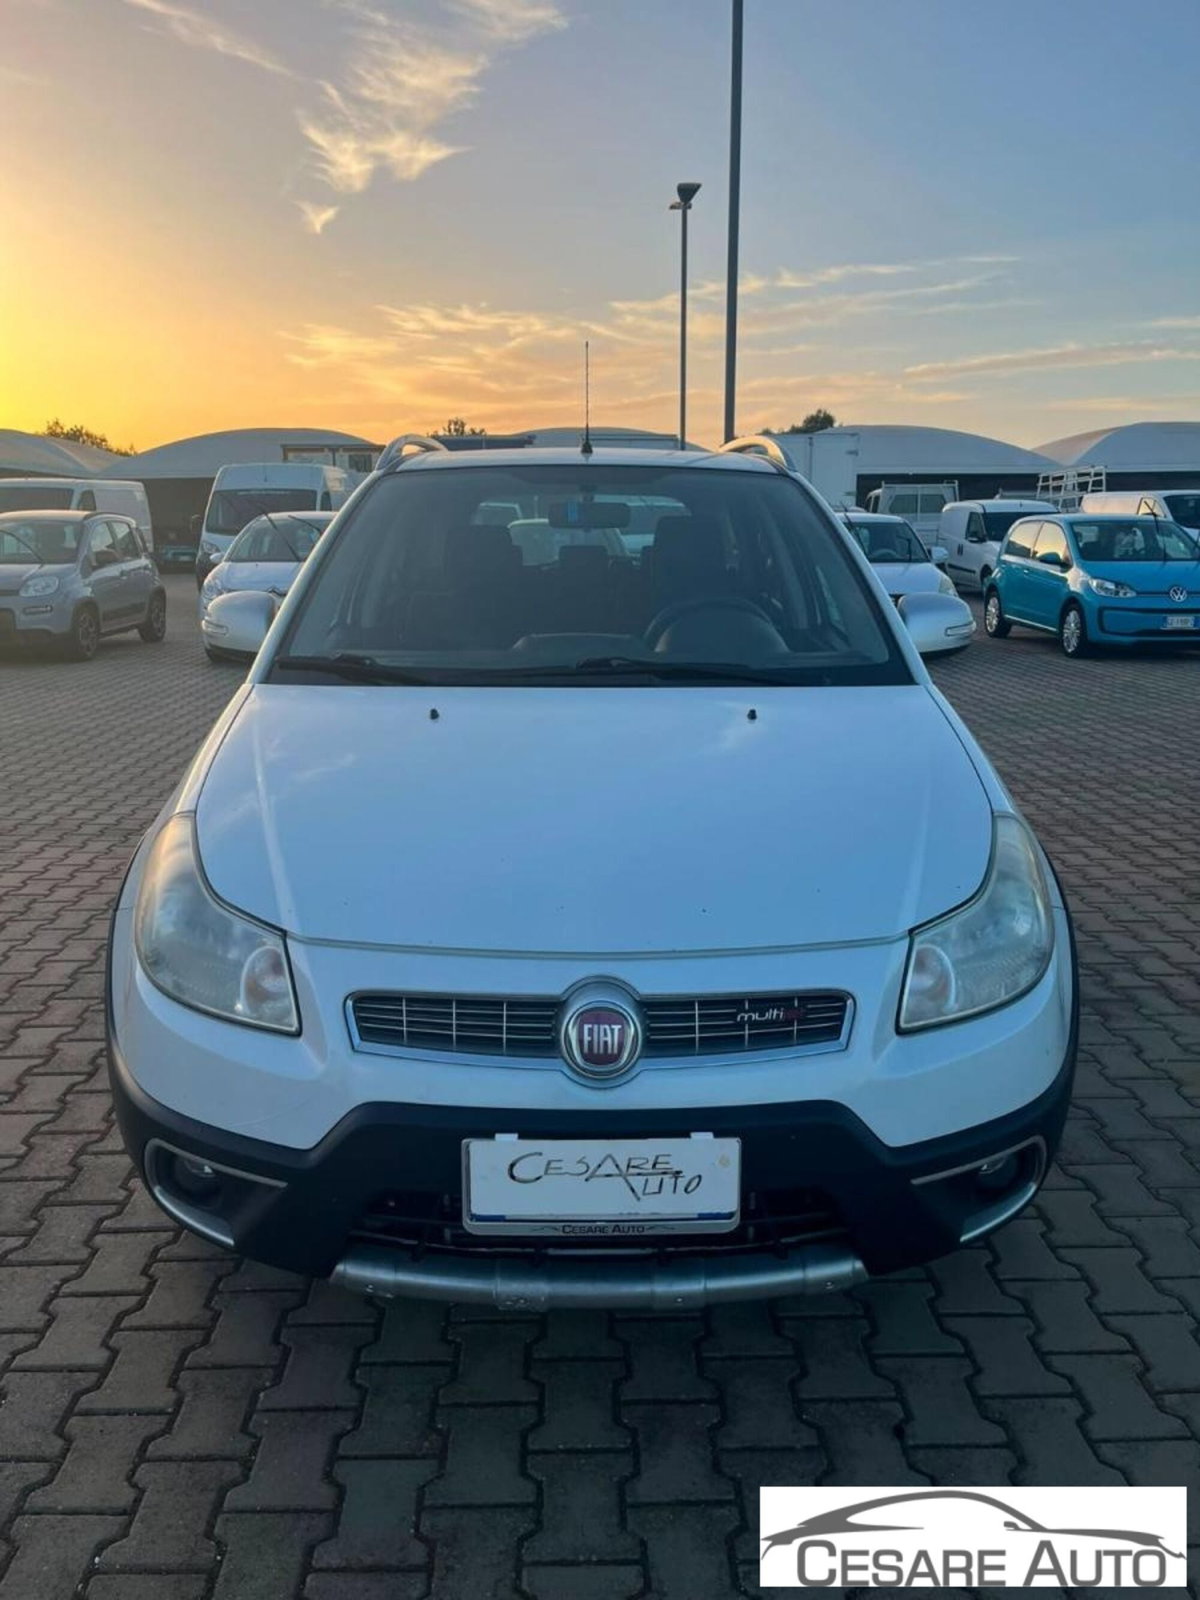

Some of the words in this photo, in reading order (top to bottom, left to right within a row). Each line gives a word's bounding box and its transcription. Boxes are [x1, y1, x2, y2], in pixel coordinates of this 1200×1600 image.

[583, 1023, 622, 1054] FIAT
[508, 1152, 674, 1183] CESARE
[562, 1224, 608, 1234] CESARE
[612, 1224, 645, 1234] AUTO
